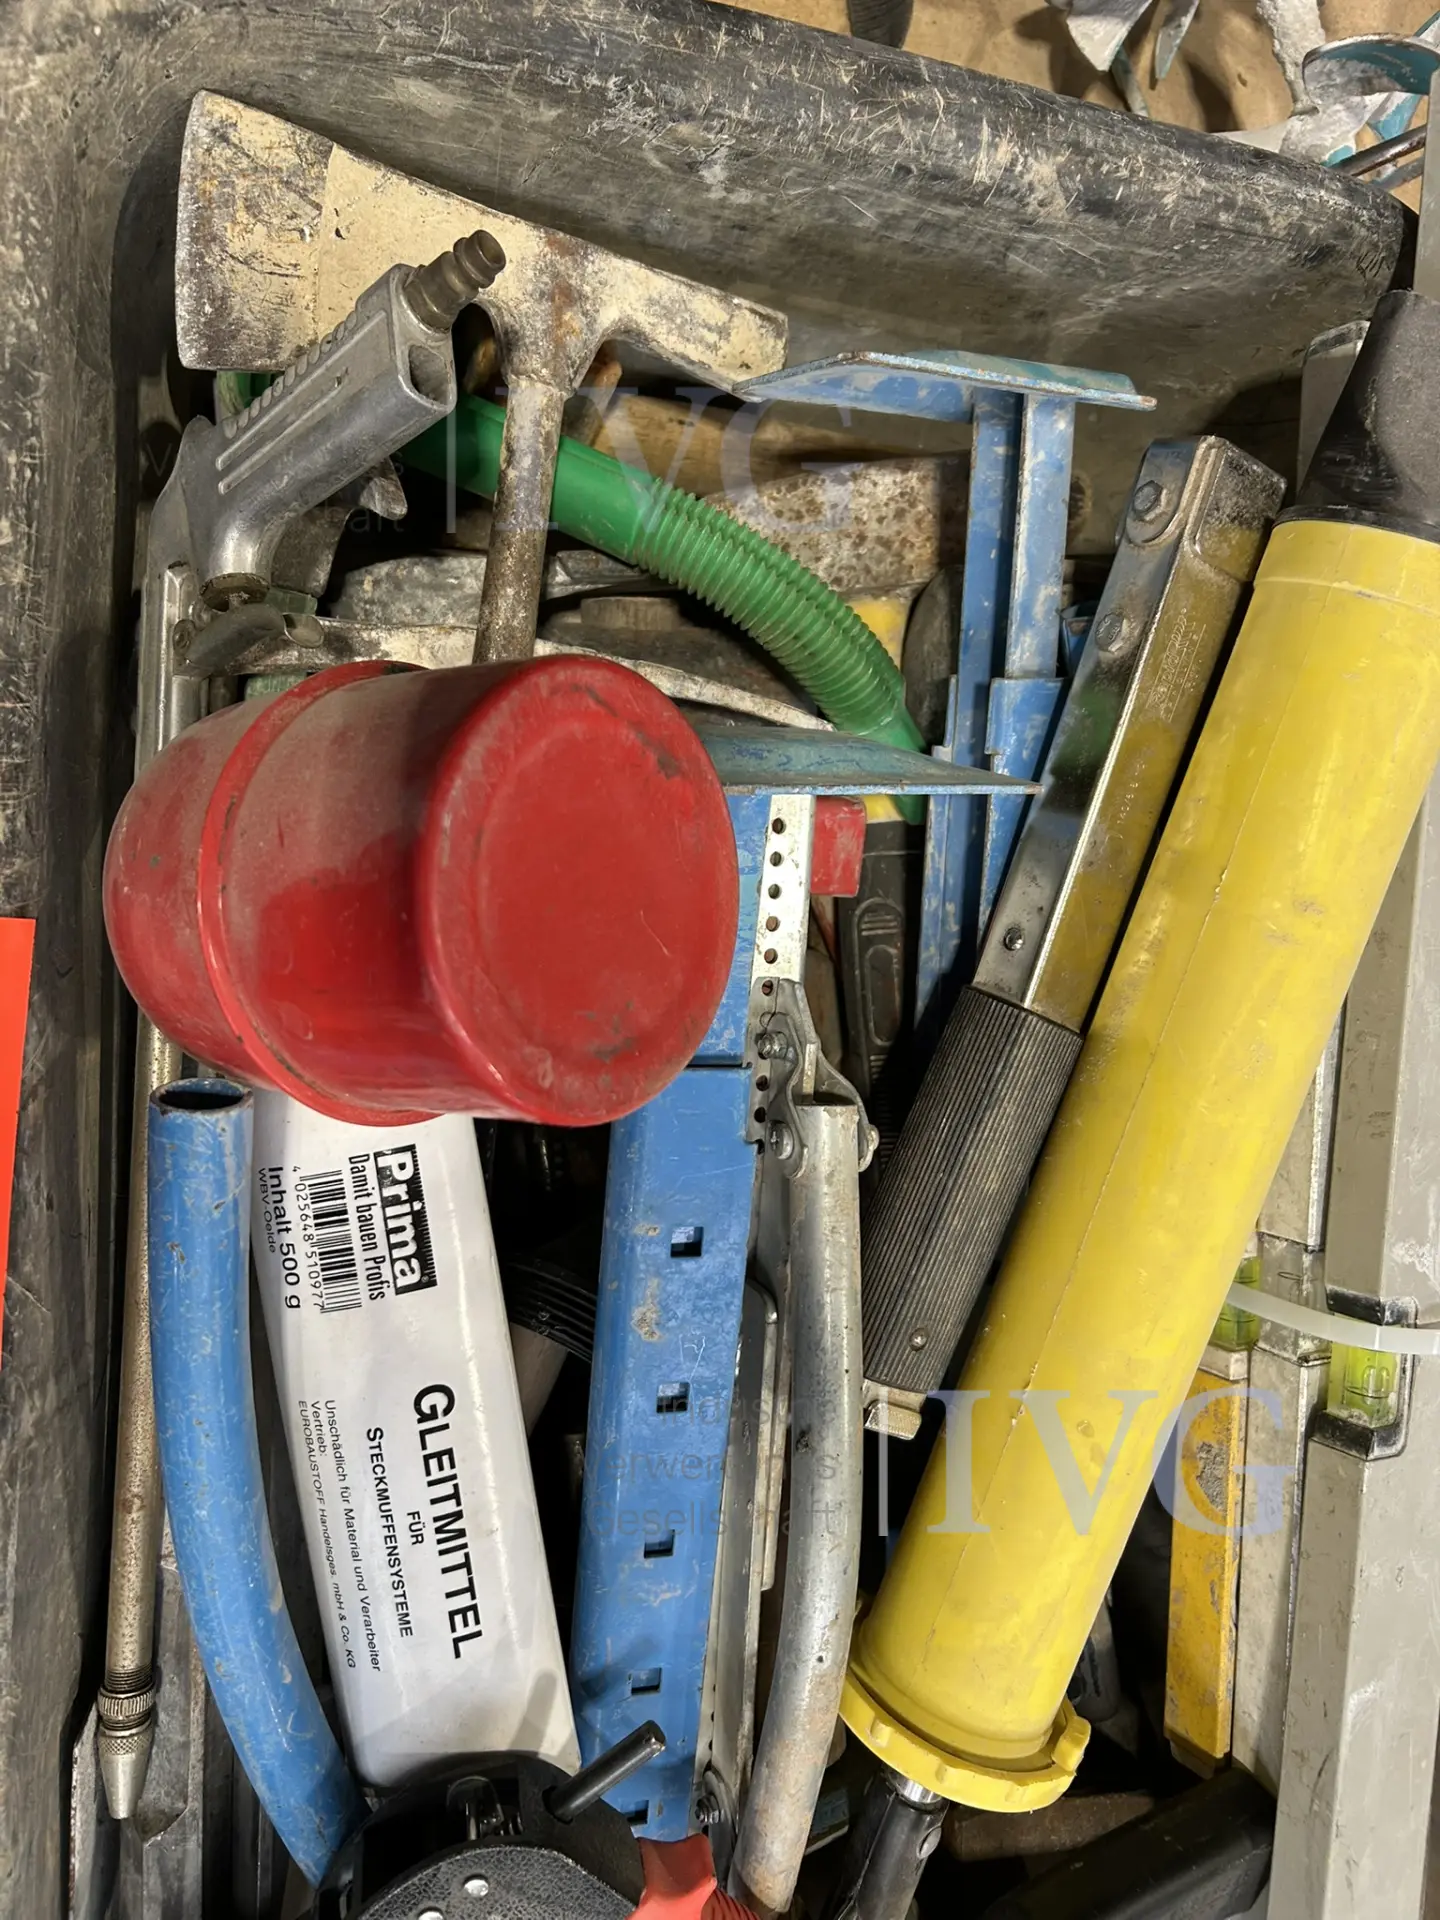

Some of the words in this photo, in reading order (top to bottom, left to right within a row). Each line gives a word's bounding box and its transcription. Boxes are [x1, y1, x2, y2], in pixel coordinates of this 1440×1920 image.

[268, 1167, 292, 1234] Inhalt
[348, 1154, 375, 1201] Damit
[258, 1167, 276, 1253] WBV-Oelde
[356, 1202, 378, 1251] bauen
[375, 1149, 424, 1289] Prima
[280, 1243, 300, 1286] 500
[294, 1183, 315, 1242] 025648
[305, 1251, 325, 1309] 510977
[285, 1294, 301, 1309] g
[363, 1255, 390, 1301] Profis
[311, 1400, 327, 1457] Vertrieb:
[325, 1400, 347, 1482] Unschädlich
[340, 1485, 351, 1505] für
[414, 1384, 482, 1659] GLEITMITTEL
[299, 1400, 326, 1506] EUROBAUSTOFF
[318, 1508, 337, 1578] Handelsges.
[332, 1582, 344, 1609] mbH
[340, 1626, 350, 1647] Co.
[345, 1648, 356, 1668] KG
[343, 1508, 360, 1560] Material
[366, 1427, 413, 1637] STECKMUFFENSYSTEME
[407, 1510, 425, 1546] FÜR
[353, 1566, 368, 1592] und
[359, 1596, 380, 1672] Verarbeiter
